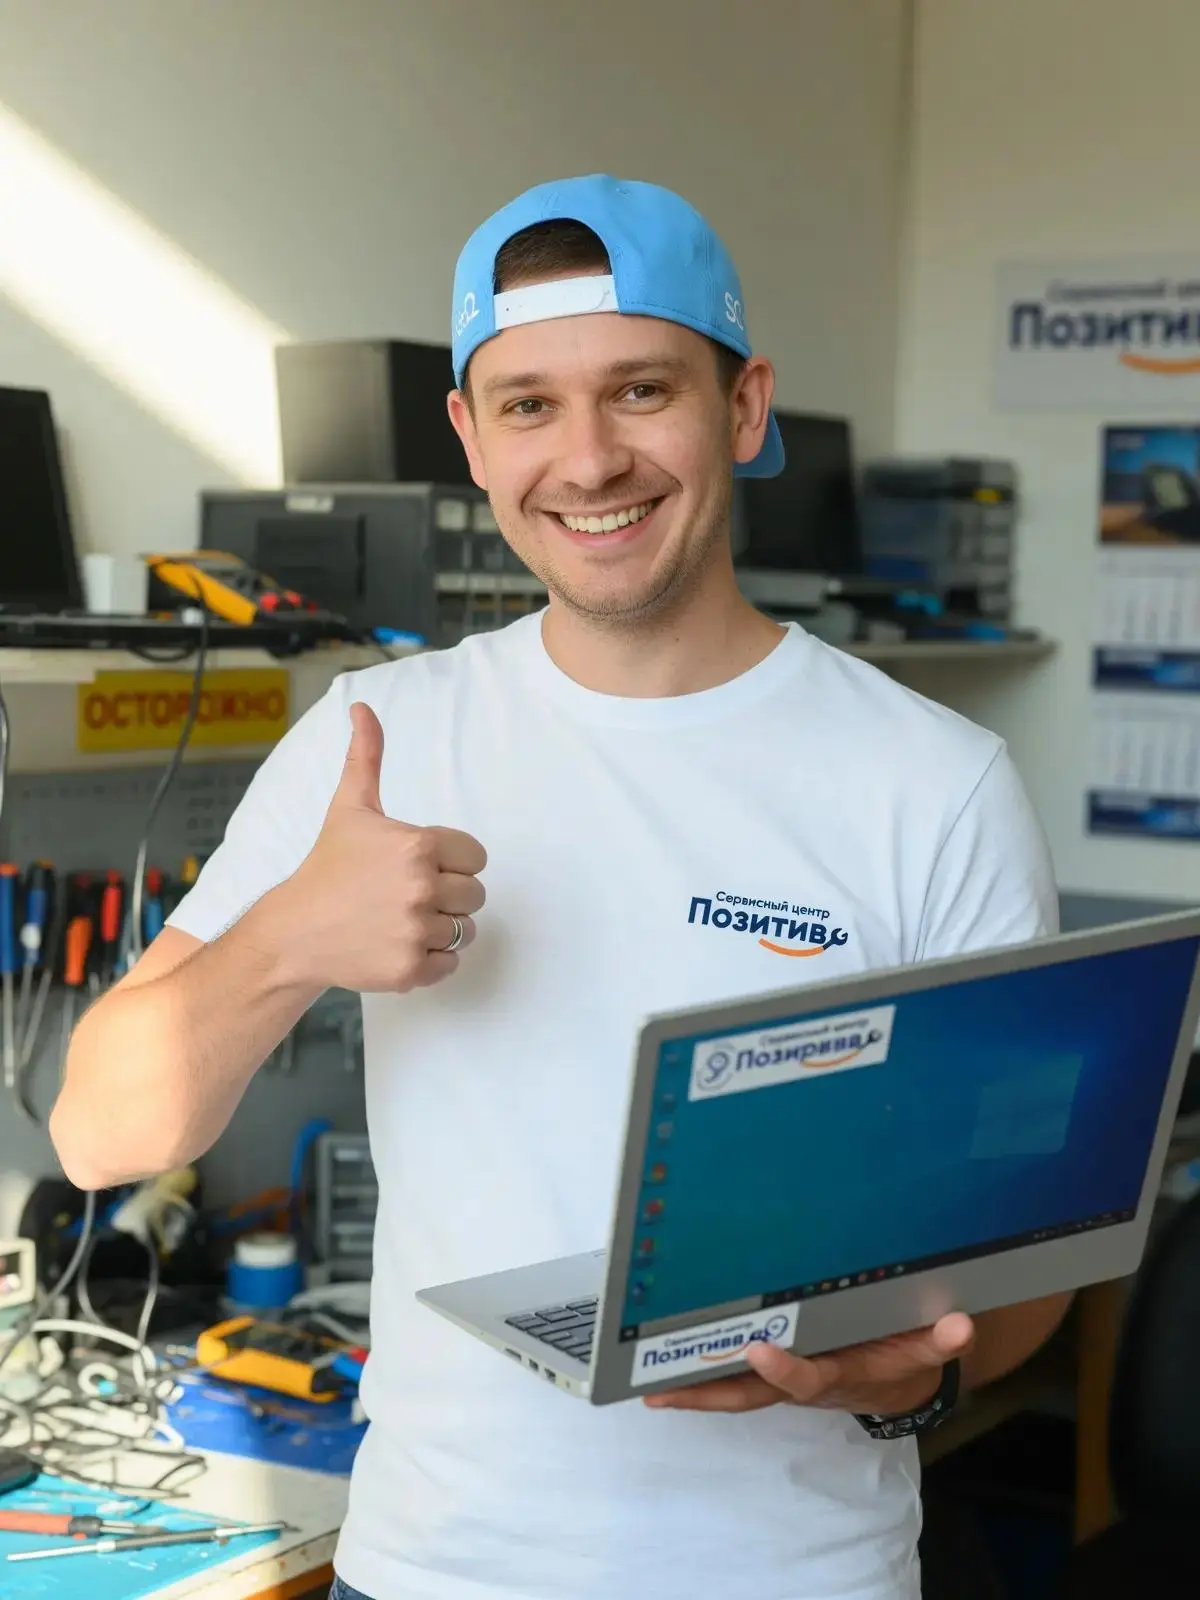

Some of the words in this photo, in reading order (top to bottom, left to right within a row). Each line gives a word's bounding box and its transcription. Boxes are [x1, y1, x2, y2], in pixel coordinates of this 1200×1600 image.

[1010, 301, 1200, 350] Позити
[687, 896, 827, 945] Позитив
[715, 890, 789, 912] Сервисный
[791, 903, 831, 921] центр
